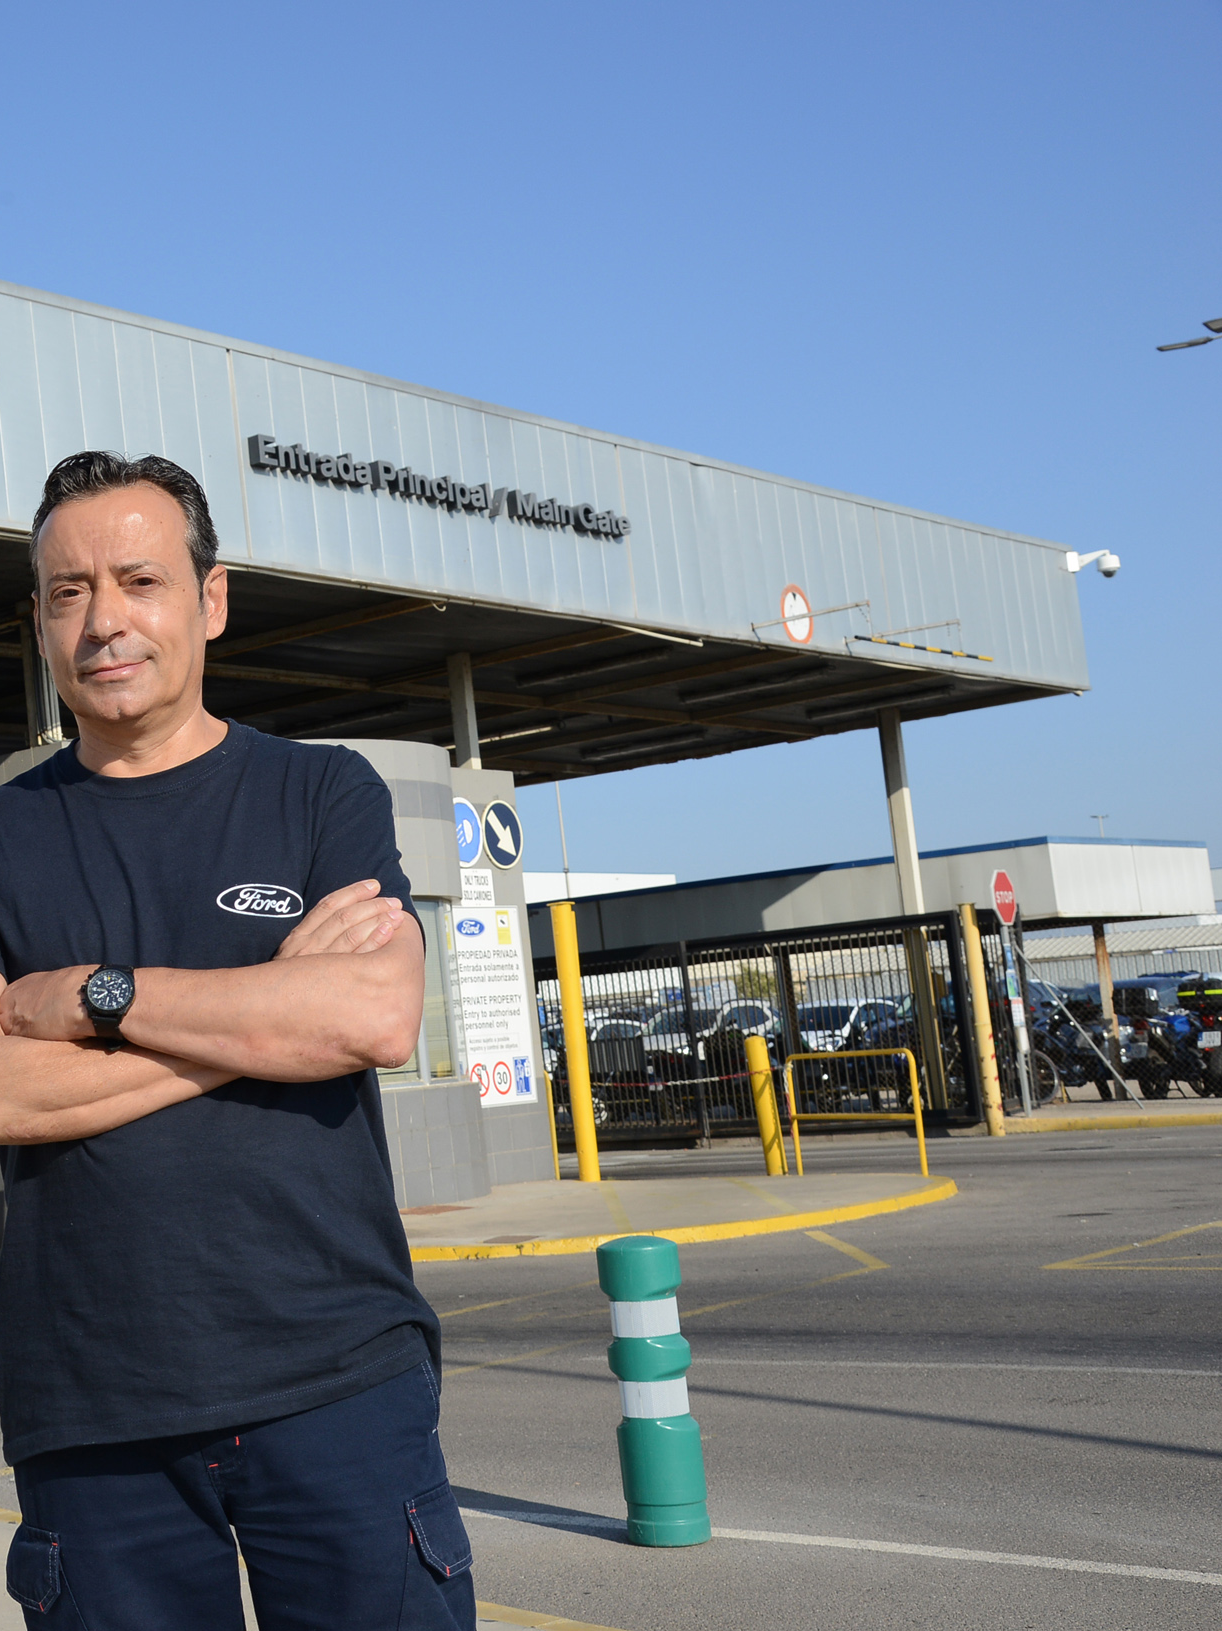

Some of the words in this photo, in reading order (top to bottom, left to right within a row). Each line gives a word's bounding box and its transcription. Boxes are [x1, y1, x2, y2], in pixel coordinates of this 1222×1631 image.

[248, 433, 373, 487] Entrada
[371, 459, 493, 512] Principal
[489, 487, 508, 518] /
[508, 489, 576, 526] Main
[574, 502, 632, 537] Gate
[234, 888, 291, 914] Ford
[995, 890, 1014, 904] STOP
[461, 920, 481, 934] Ford
[458, 950, 491, 960] PROPIEDAD
[492, 949, 518, 959] PRIVADA
[459, 963, 482, 972] Entrada
[483, 962, 514, 972] solamente
[460, 974, 486, 985] personal
[487, 973, 520, 982] autorizado
[462, 995, 488, 1006] PRIVATE
[489, 994, 522, 1005] PROPERTY
[464, 1009, 480, 1020] Entry
[481, 1010, 488, 1018] to
[489, 1008, 521, 1018] authorised
[465, 1020, 495, 1031] personnel
[496, 1019, 509, 1029] only
[496, 1071, 508, 1085] 30
